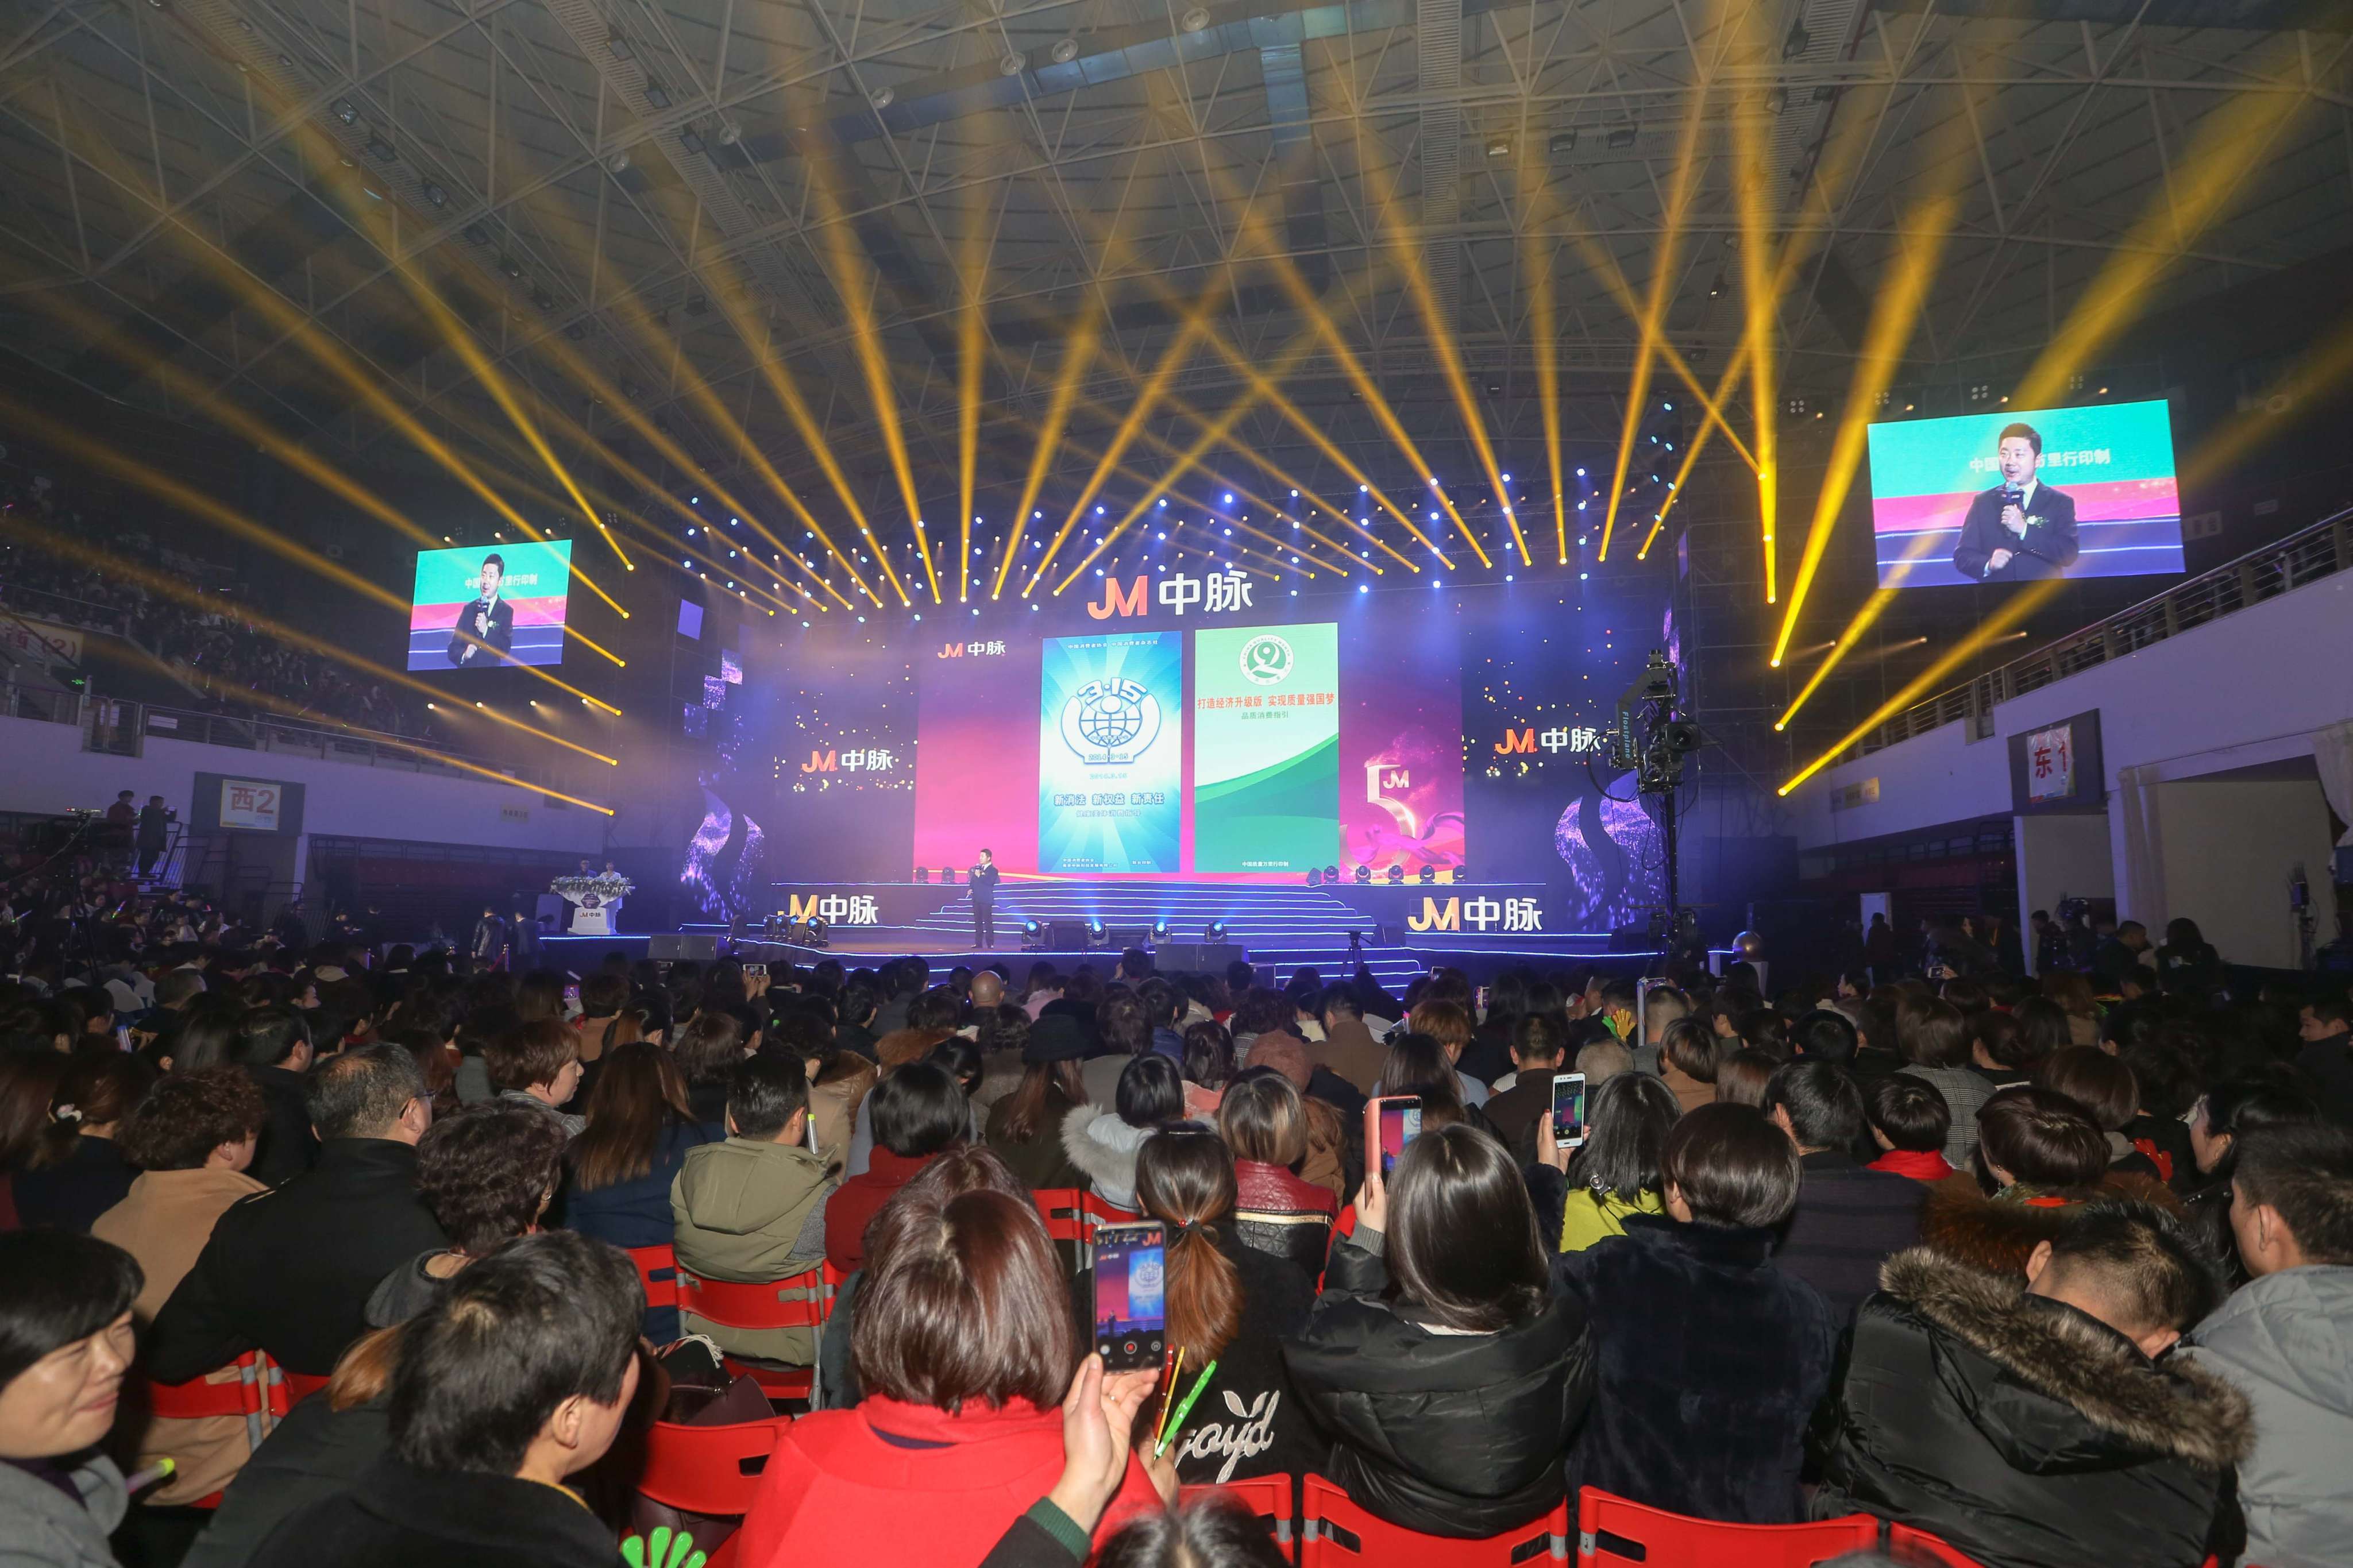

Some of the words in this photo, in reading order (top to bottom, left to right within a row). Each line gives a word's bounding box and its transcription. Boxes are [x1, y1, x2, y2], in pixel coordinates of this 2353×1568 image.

[1087, 575, 1148, 620] JM
[1159, 570, 1253, 616] 中脉
[937, 642, 963, 659] JM
[967, 640, 1006, 656] 中脉
[1197, 696, 1263, 709] 打造经济升级版
[1268, 692, 1335, 707] 实现质量强国梦
[1241, 710, 1289, 720] 品质消费指引
[1494, 728, 1535, 755] JM
[1541, 727, 1602, 754] 中脉
[801, 750, 836, 773] JM
[841, 748, 893, 772] 中脉
[1383, 770, 1410, 789] JM
[1054, 794, 1086, 806] 新消法
[1091, 793, 1125, 806] 新权益
[1131, 792, 1166, 805] 新责任
[819, 894, 880, 925] 中脉
[1407, 897, 1460, 932] JM
[1464, 895, 1543, 932] 中脉
